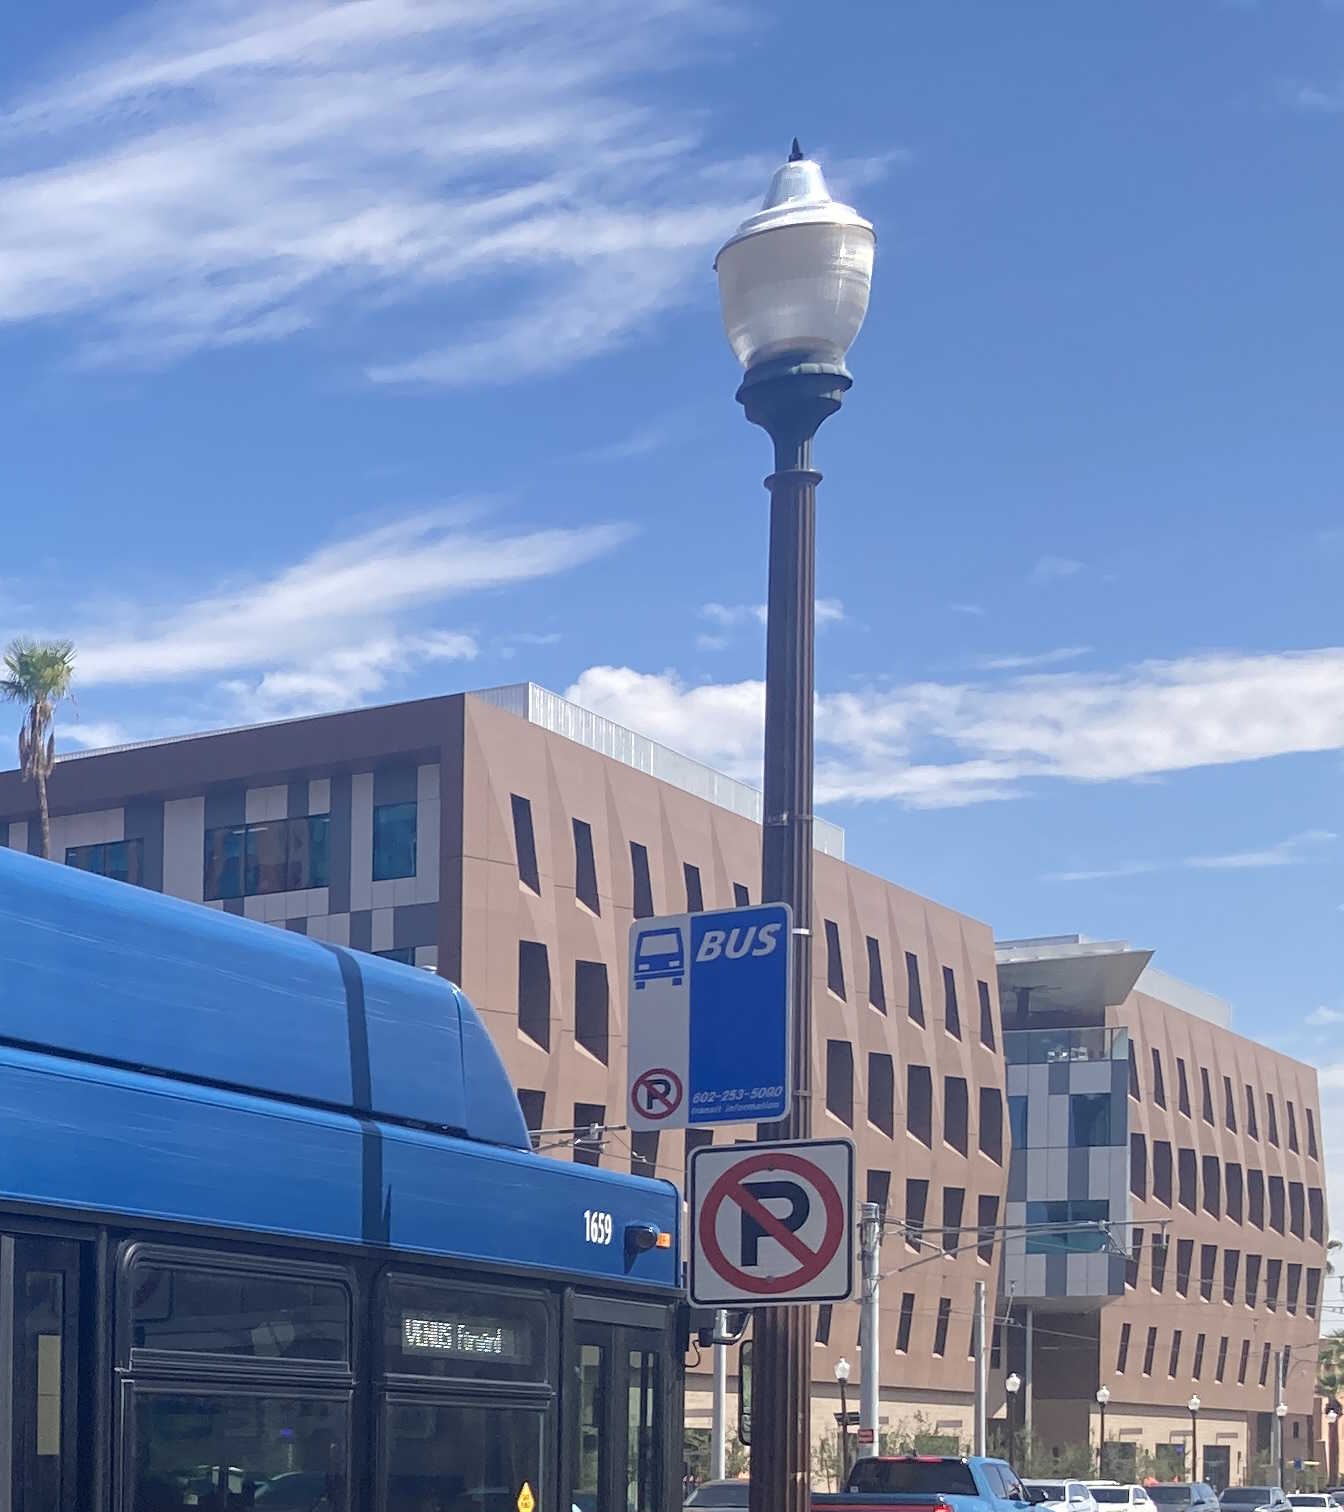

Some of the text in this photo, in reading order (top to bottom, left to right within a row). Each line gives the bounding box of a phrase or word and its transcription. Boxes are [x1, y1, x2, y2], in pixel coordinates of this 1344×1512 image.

[696, 923, 782, 963] BUS
[583, 1209, 613, 1245] 1659
[405, 1319, 453, 1349] VENUS
